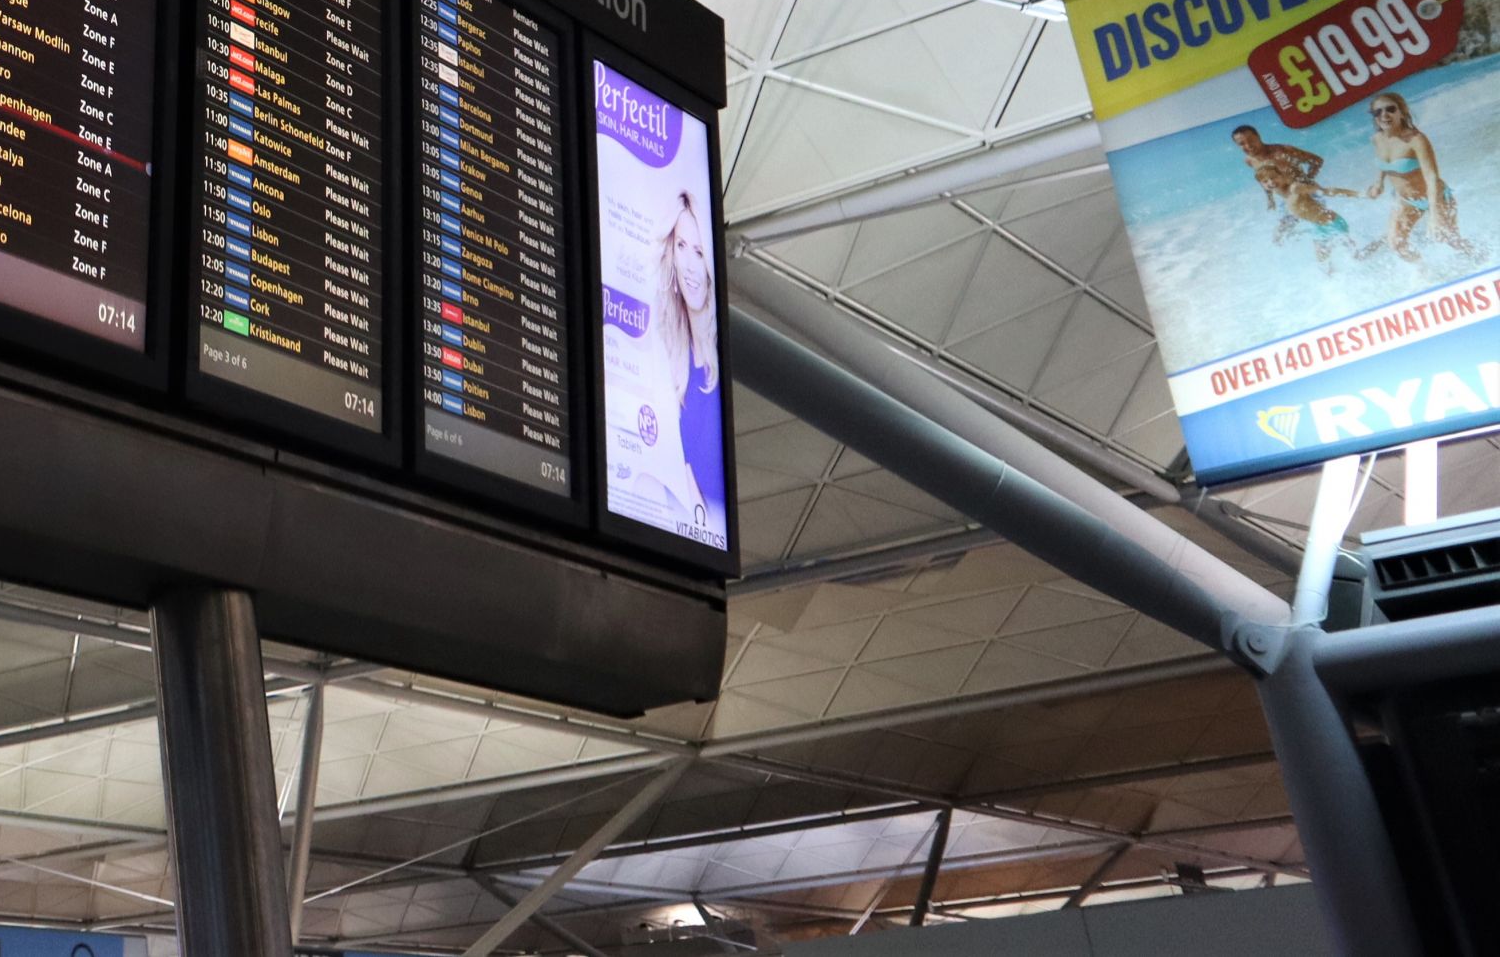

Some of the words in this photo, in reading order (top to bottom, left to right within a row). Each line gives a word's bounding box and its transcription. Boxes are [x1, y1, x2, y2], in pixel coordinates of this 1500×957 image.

[79, 98, 104, 121] Zone
[106, 112, 113, 125] C
[594, 60, 670, 141] Perfectil
[205, 107, 228, 127] 11:00
[253, 129, 291, 157] Katowice
[325, 163, 349, 185] Please
[350, 175, 369, 194] Wait
[72, 255, 97, 277] Zone
[100, 266, 106, 280] F
[98, 302, 135, 332] 07:14
[1210, 357, 1270, 396] OVER
[1274, 342, 1313, 376] 140
[1316, 285, 1492, 362] DESTINATIONS
[344, 391, 374, 417] 07:14
[676, 521, 725, 549] VITABIOTICS
